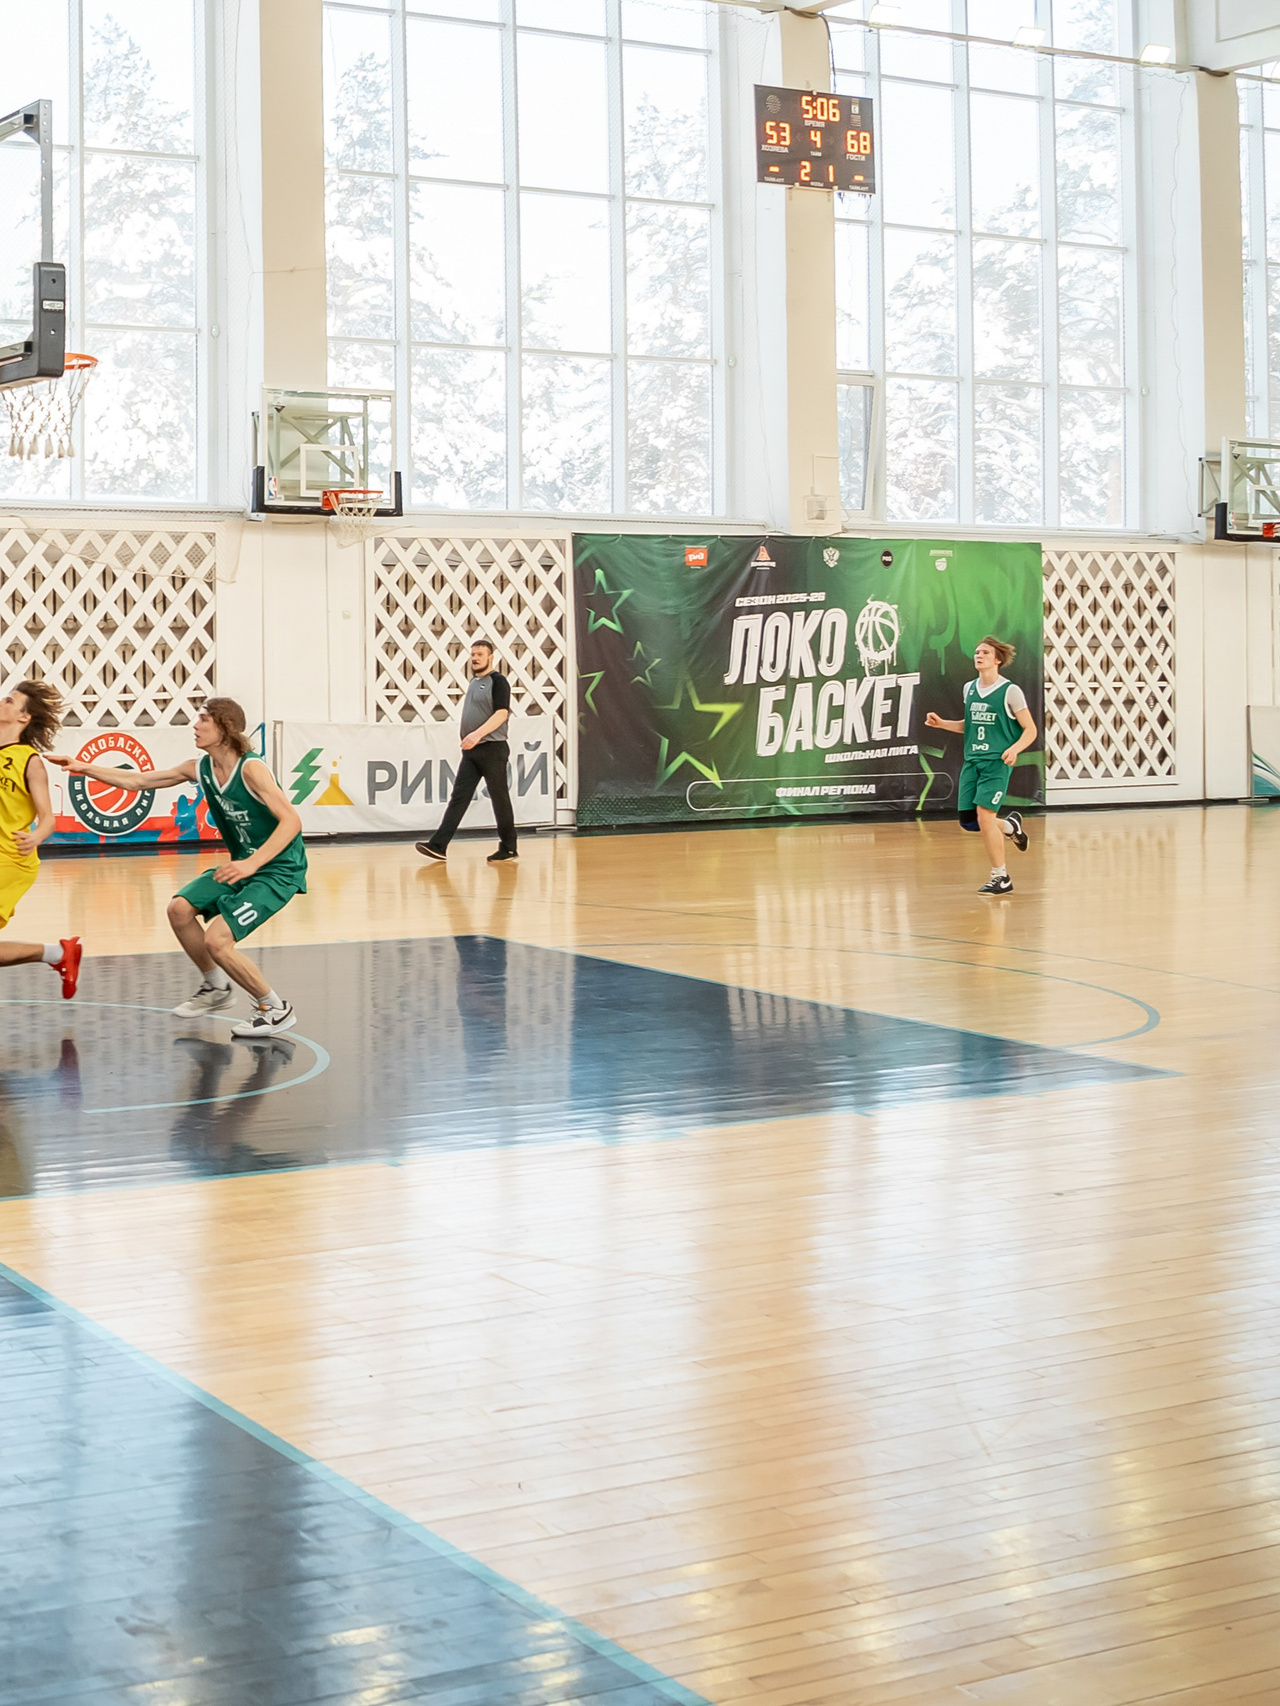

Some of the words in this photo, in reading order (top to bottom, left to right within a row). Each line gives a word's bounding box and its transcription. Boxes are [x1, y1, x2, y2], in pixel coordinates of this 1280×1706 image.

[801, 95, 840, 122] 5:06
[765, 120, 791, 146] 53
[809, 129, 822, 149] 4
[846, 129, 872, 155] 68
[800, 160, 812, 182] 2
[827, 164, 835, 183] 1
[735, 595, 776, 607] СЕЗОН
[776, 592, 826, 605] 2025-26
[723, 608, 848, 685] ЛОКО
[756, 672, 920, 757] БАСКЕТ
[977, 726, 985, 741] 8
[3, 757, 13, 770] 2
[80, 736, 152, 771] ОКОБАСКЕТ
[824, 748, 887, 763] ШКОЛЬНАЯ
[888, 745, 919, 757] ЛИГА
[367, 740, 549, 805] РИМЙ
[775, 785, 820, 797] ФИНАЛ
[820, 784, 876, 796] РЕГИОНА
[991, 791, 1003, 805] 8
[74, 781, 129, 828] ШКОЛЬНАЯ
[135, 790, 151, 816] ЛИГ
[232, 901, 258, 926] 10
